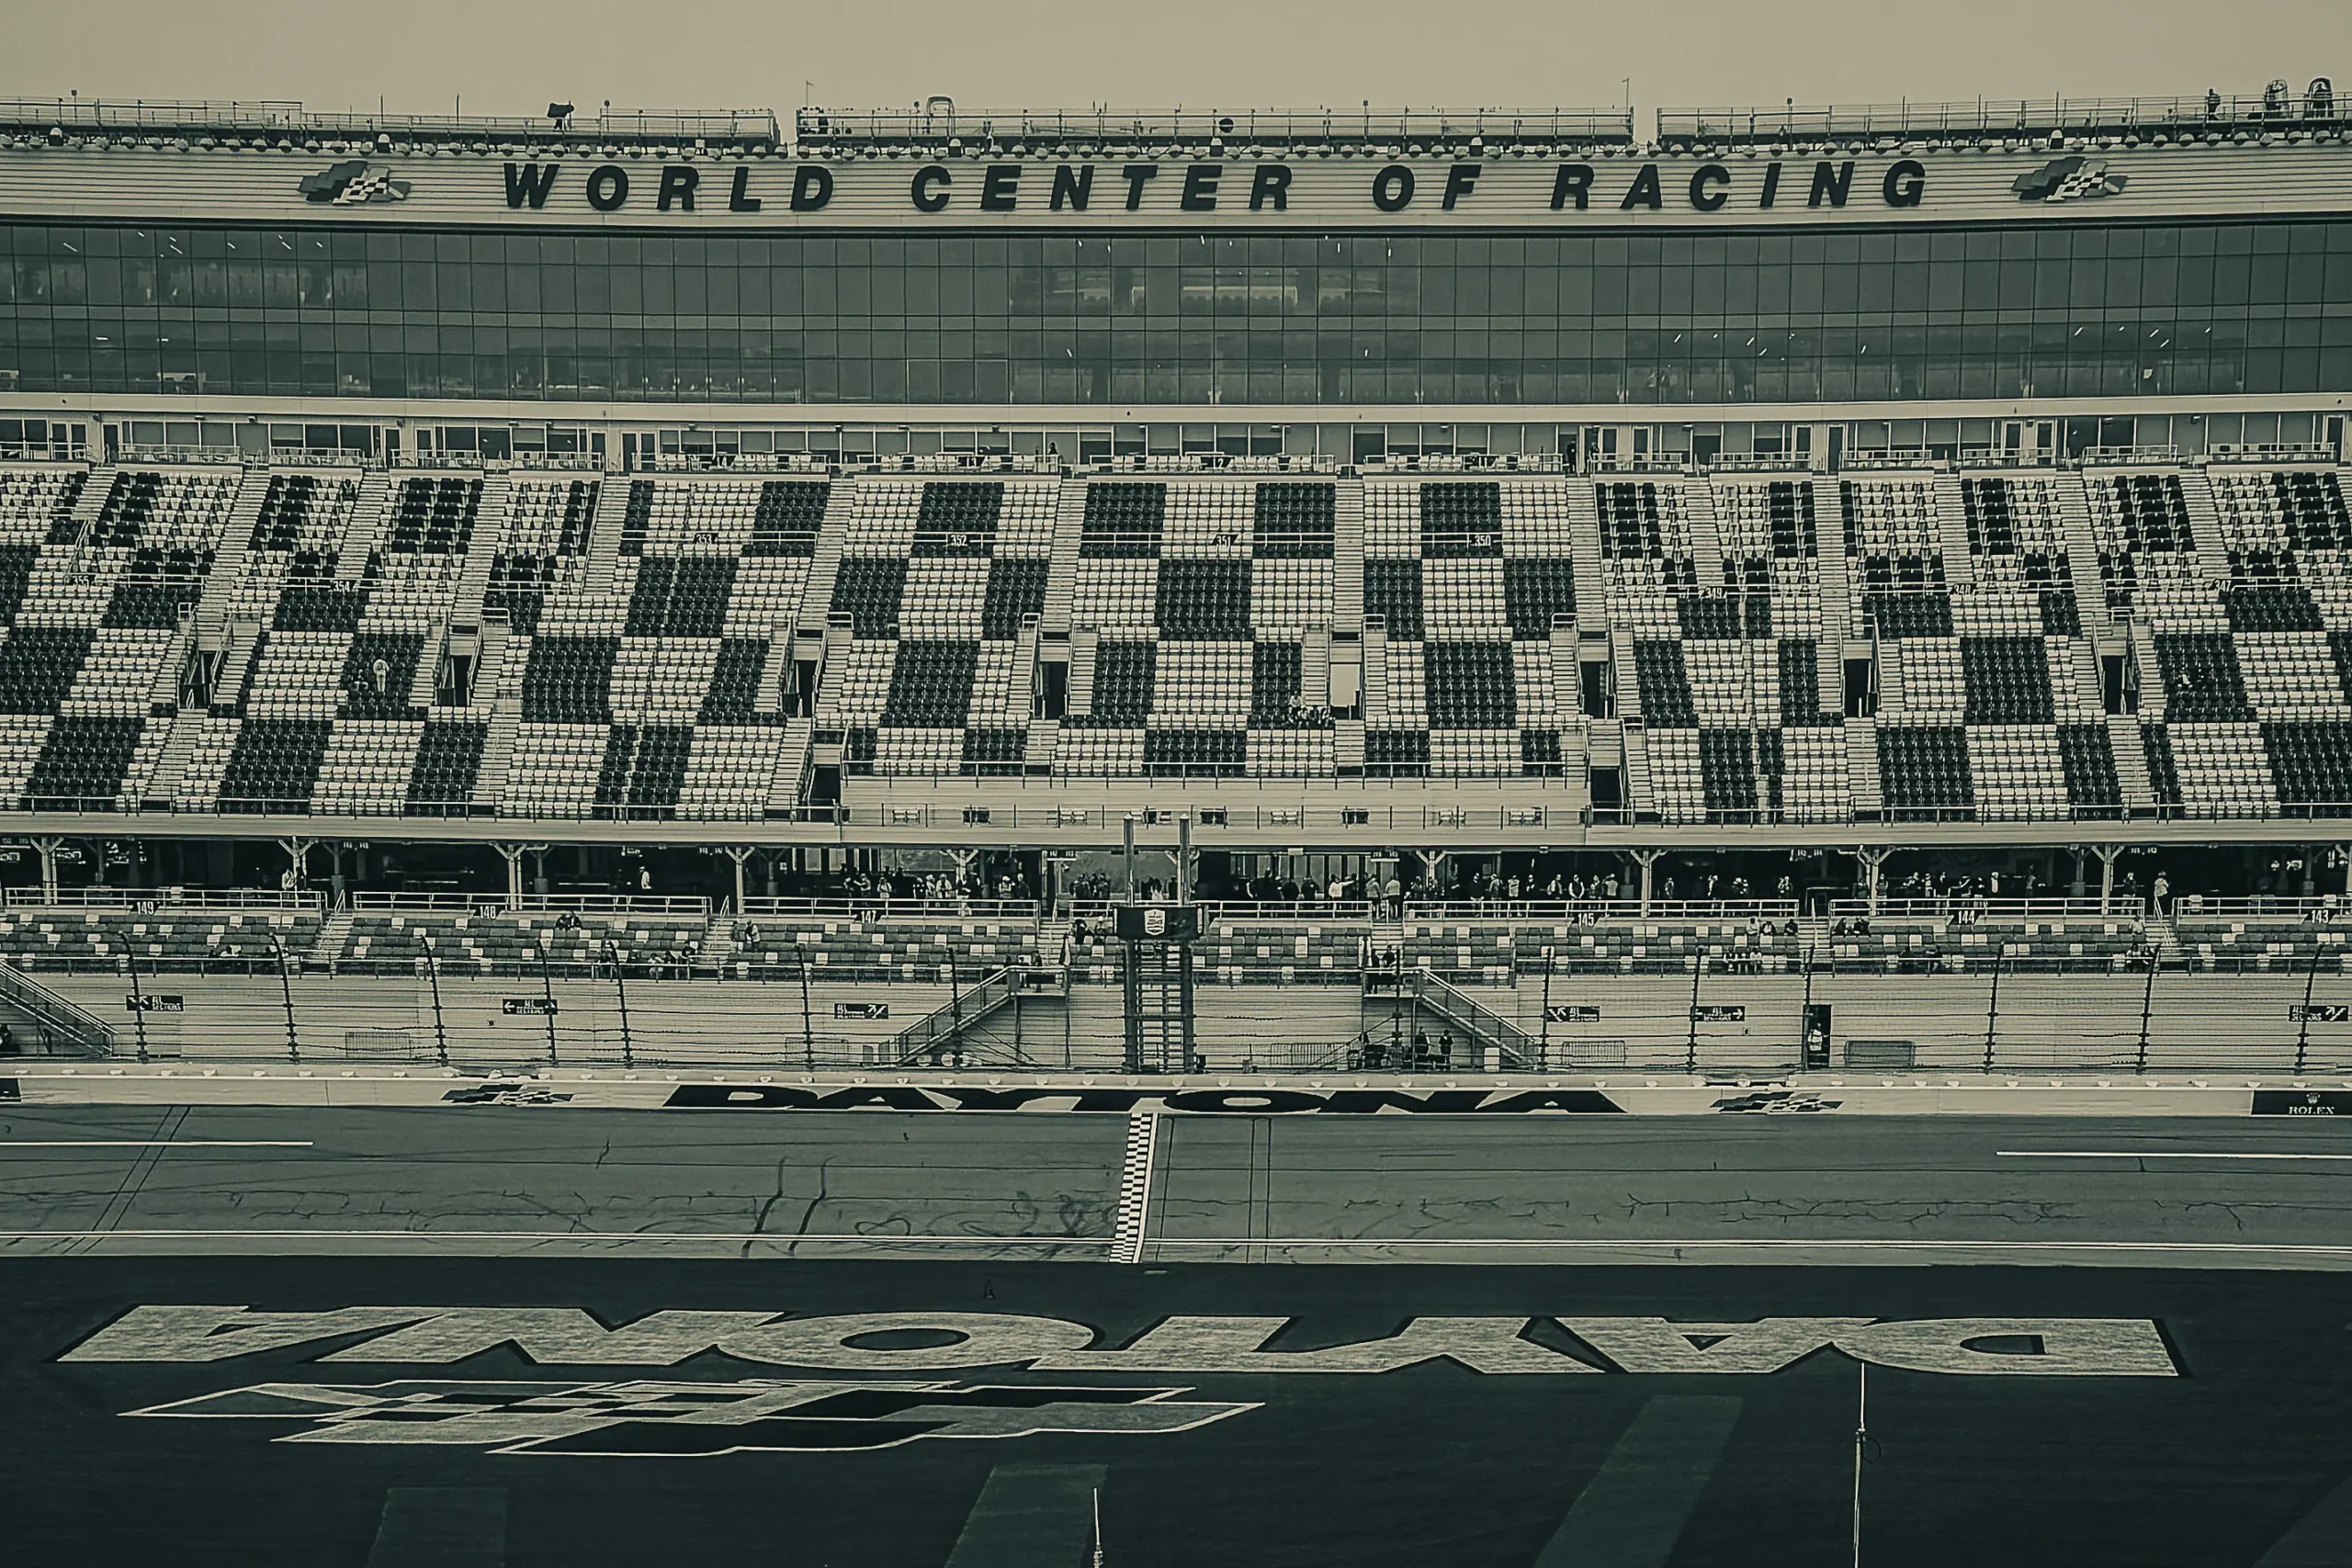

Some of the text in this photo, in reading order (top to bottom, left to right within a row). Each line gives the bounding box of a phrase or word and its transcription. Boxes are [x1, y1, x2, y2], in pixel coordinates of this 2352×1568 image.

[503, 160, 1924, 212] WORLD CENTER OF RACING
[950, 535, 967, 546] 352
[1216, 535, 1231, 547] 351
[1475, 535, 1491, 547] 350
[334, 580, 350, 592] 354
[1706, 587, 1722, 599] 349
[2214, 580, 2231, 592] 347
[136, 901, 154, 915] 149
[480, 905, 496, 919] 148
[861, 910, 876, 924] 147
[1577, 912, 1595, 927] 145
[1958, 910, 1974, 925] 144
[2311, 909, 2329, 924] 143
[662, 1085, 1627, 1113] DAYTONA
[2289, 1106, 2335, 1115] ROLEX
[57, 1305, 2178, 1377] DAYTONA
